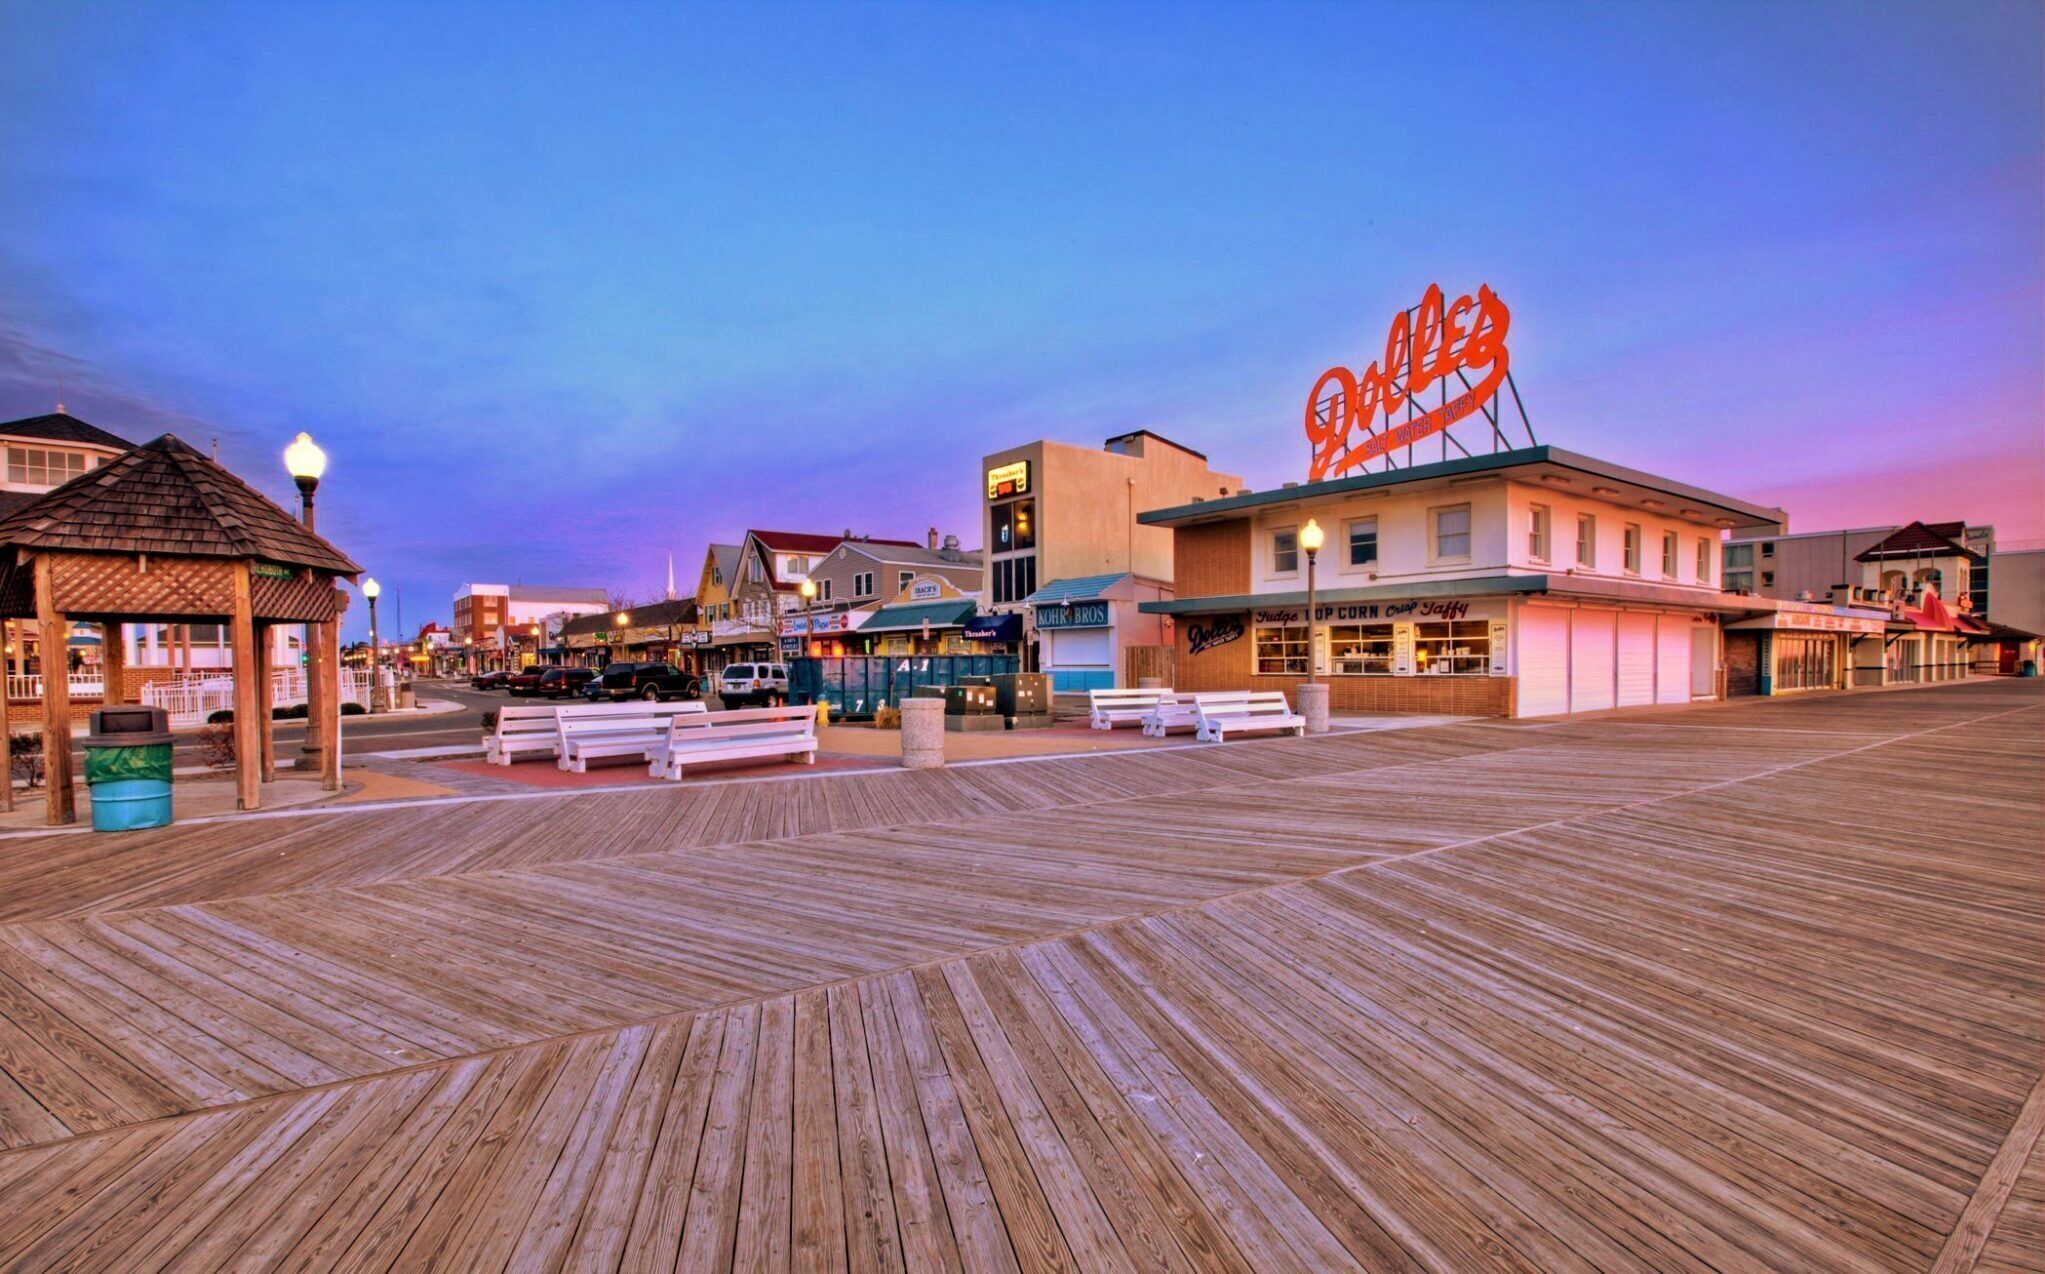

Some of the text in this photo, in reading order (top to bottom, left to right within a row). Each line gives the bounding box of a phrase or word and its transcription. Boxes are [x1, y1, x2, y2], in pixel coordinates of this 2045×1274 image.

[1366, 391, 1476, 456] SALT WATER TAFFY
[1038, 608, 1067, 625] KOHR
[1256, 610, 1298, 627] Fudge
[1338, 605, 1379, 620] CORN
[1420, 601, 1469, 619] Taffy
[964, 629, 997, 638] Thrasher's
